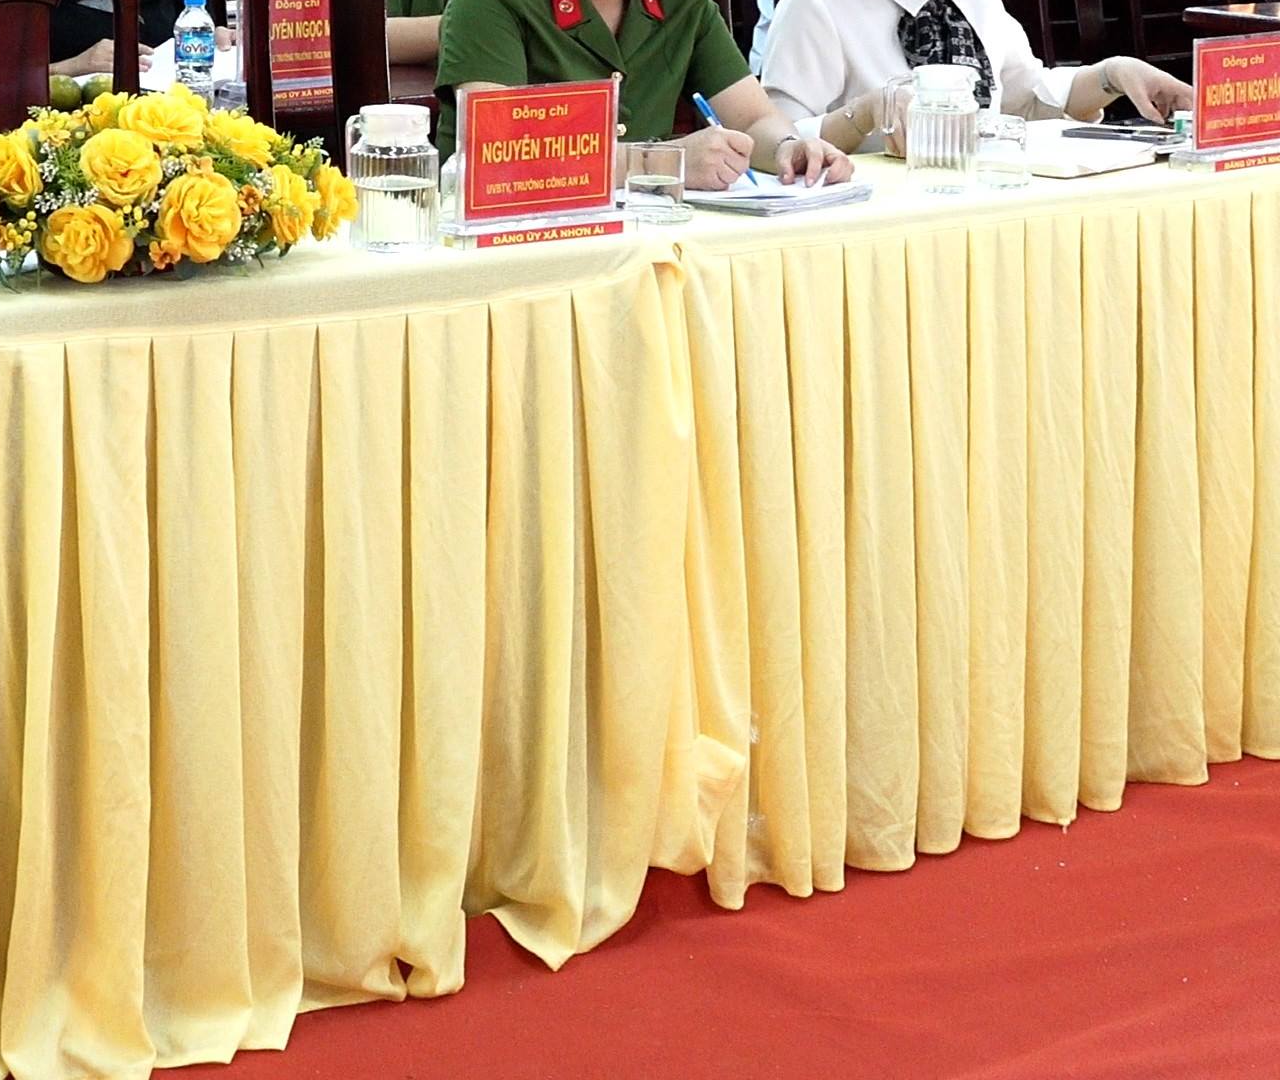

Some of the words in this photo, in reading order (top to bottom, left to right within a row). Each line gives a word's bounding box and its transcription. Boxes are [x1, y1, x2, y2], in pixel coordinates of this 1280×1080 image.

[296, 20, 323, 42] NGỌC
[512, 105, 546, 120] Đồng
[549, 104, 568, 117] chí
[482, 134, 540, 164] NGUYỄN
[544, 135, 566, 162] THỊ
[570, 133, 600, 160] LỊCH
[546, 176, 566, 189] CÔNG
[568, 177, 579, 187] AN
[493, 233, 524, 245] ĐẢNG
[527, 231, 542, 242] ỦY
[543, 229, 558, 240] XÃ
[561, 226, 592, 238] NHƠN
